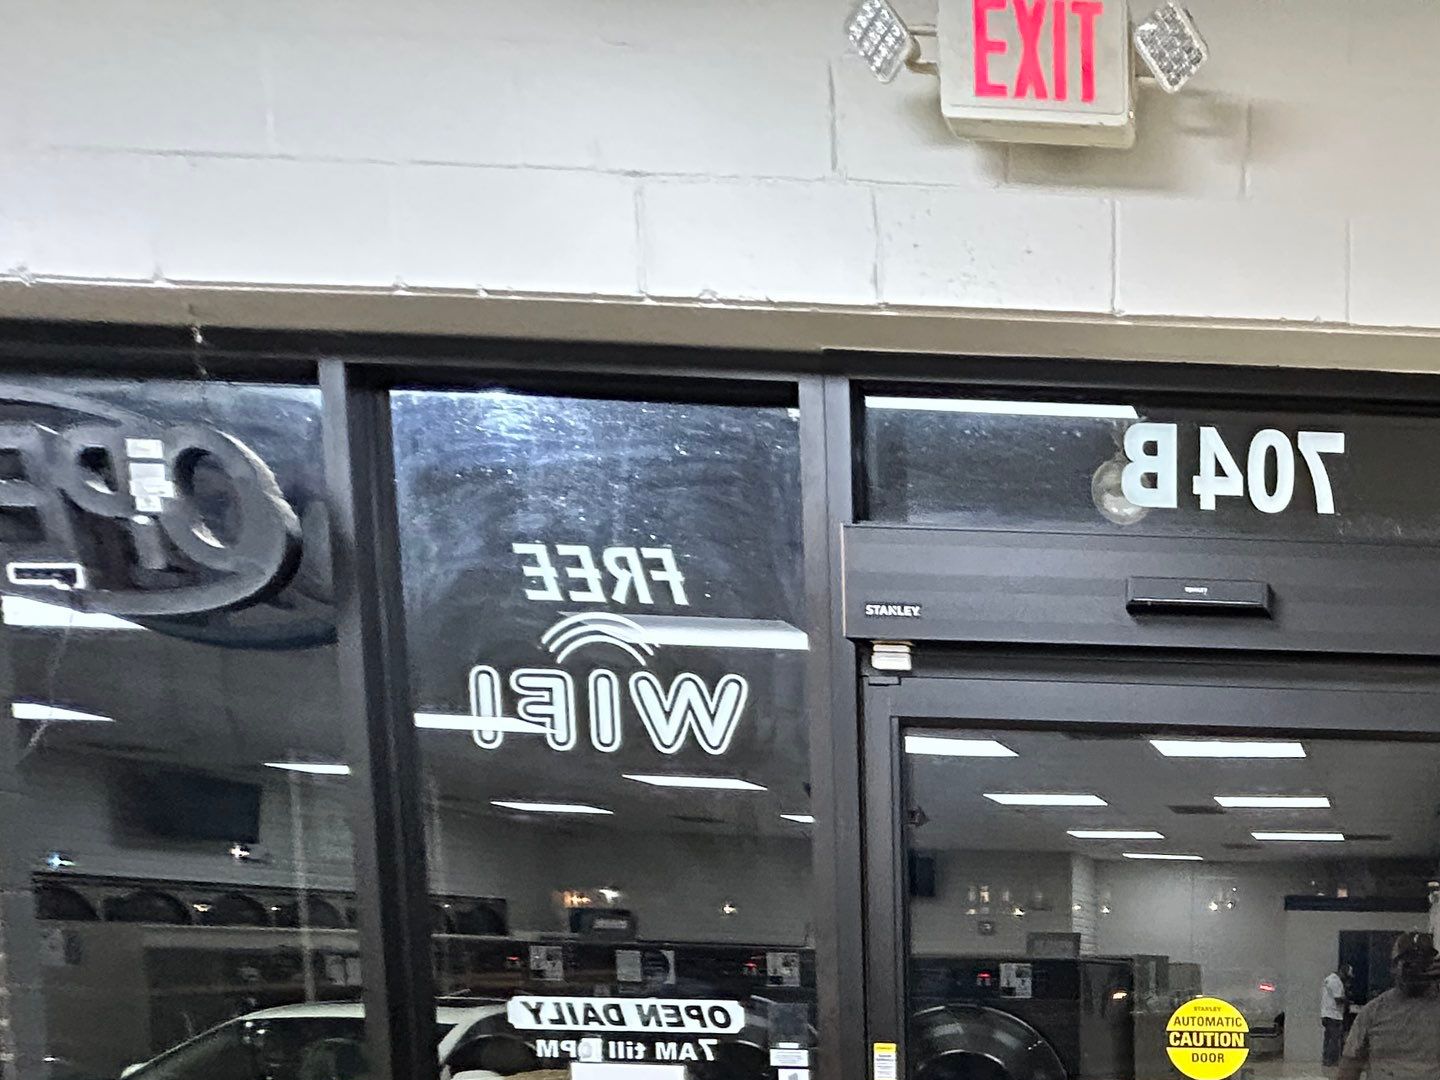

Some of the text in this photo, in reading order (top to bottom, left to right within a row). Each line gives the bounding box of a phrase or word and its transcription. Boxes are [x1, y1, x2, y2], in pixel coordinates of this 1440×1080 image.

[973, 0, 1104, 102] EXIT
[865, 604, 921, 616] STANLEY
[1173, 1016, 1242, 1028] AUTOMATIC
[1169, 1031, 1245, 1048] CAUTION
[1191, 1053, 1225, 1063] DOOR
